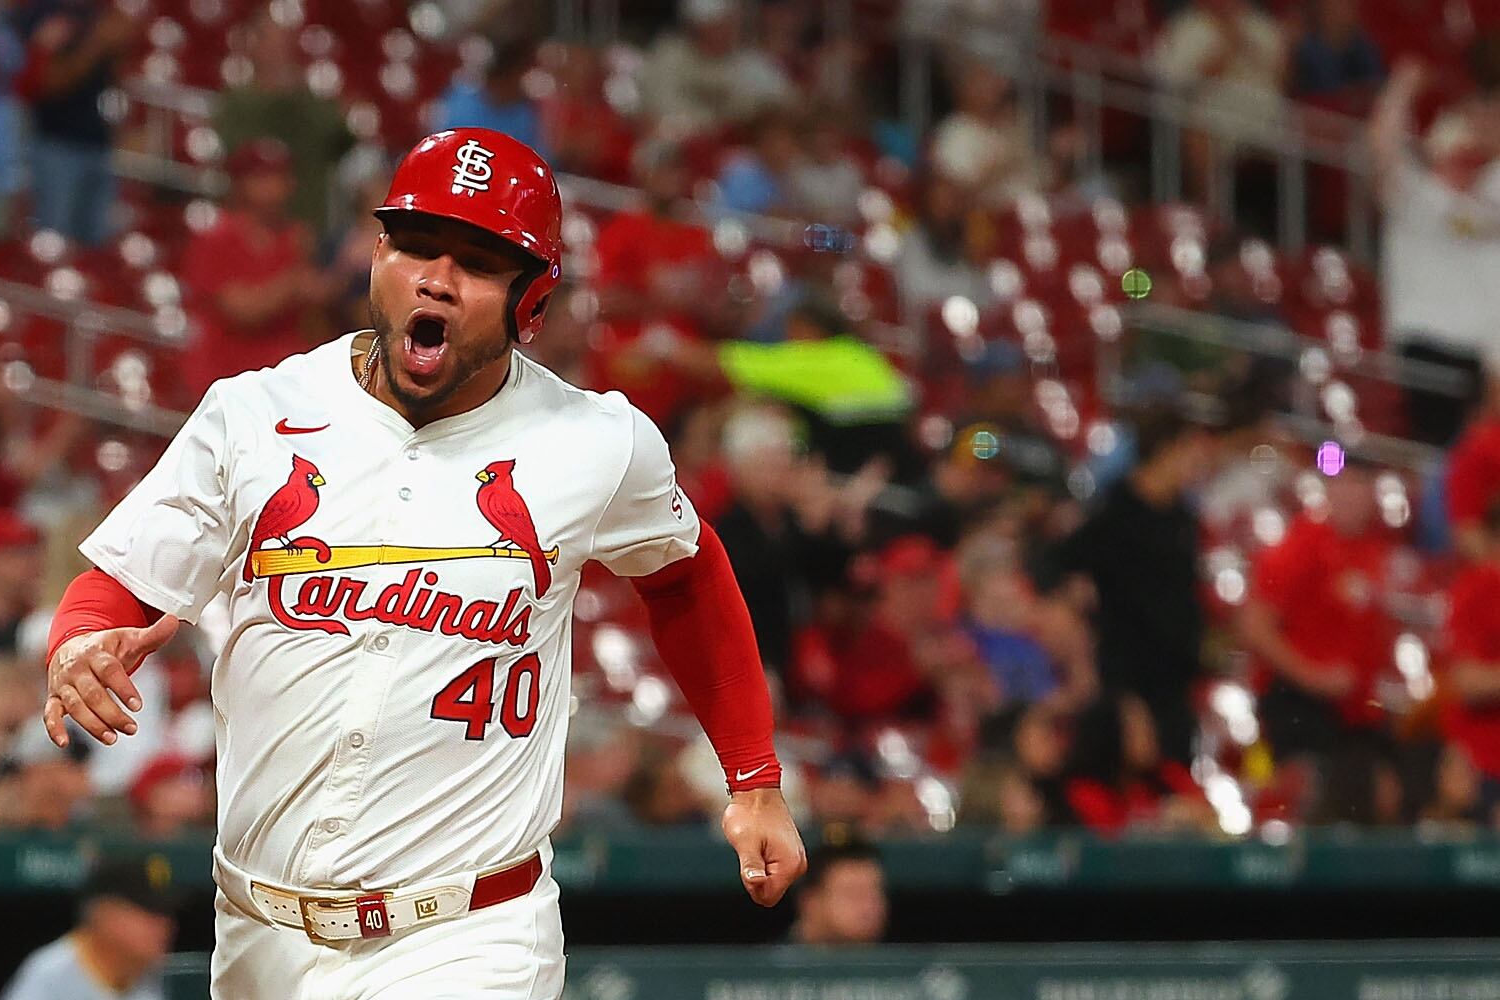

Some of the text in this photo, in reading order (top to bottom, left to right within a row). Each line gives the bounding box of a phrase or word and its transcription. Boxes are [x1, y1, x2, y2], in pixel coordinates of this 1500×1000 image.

[268, 536, 533, 648] Cardinals
[430, 651, 542, 741] 40
[365, 909, 383, 930] 40
